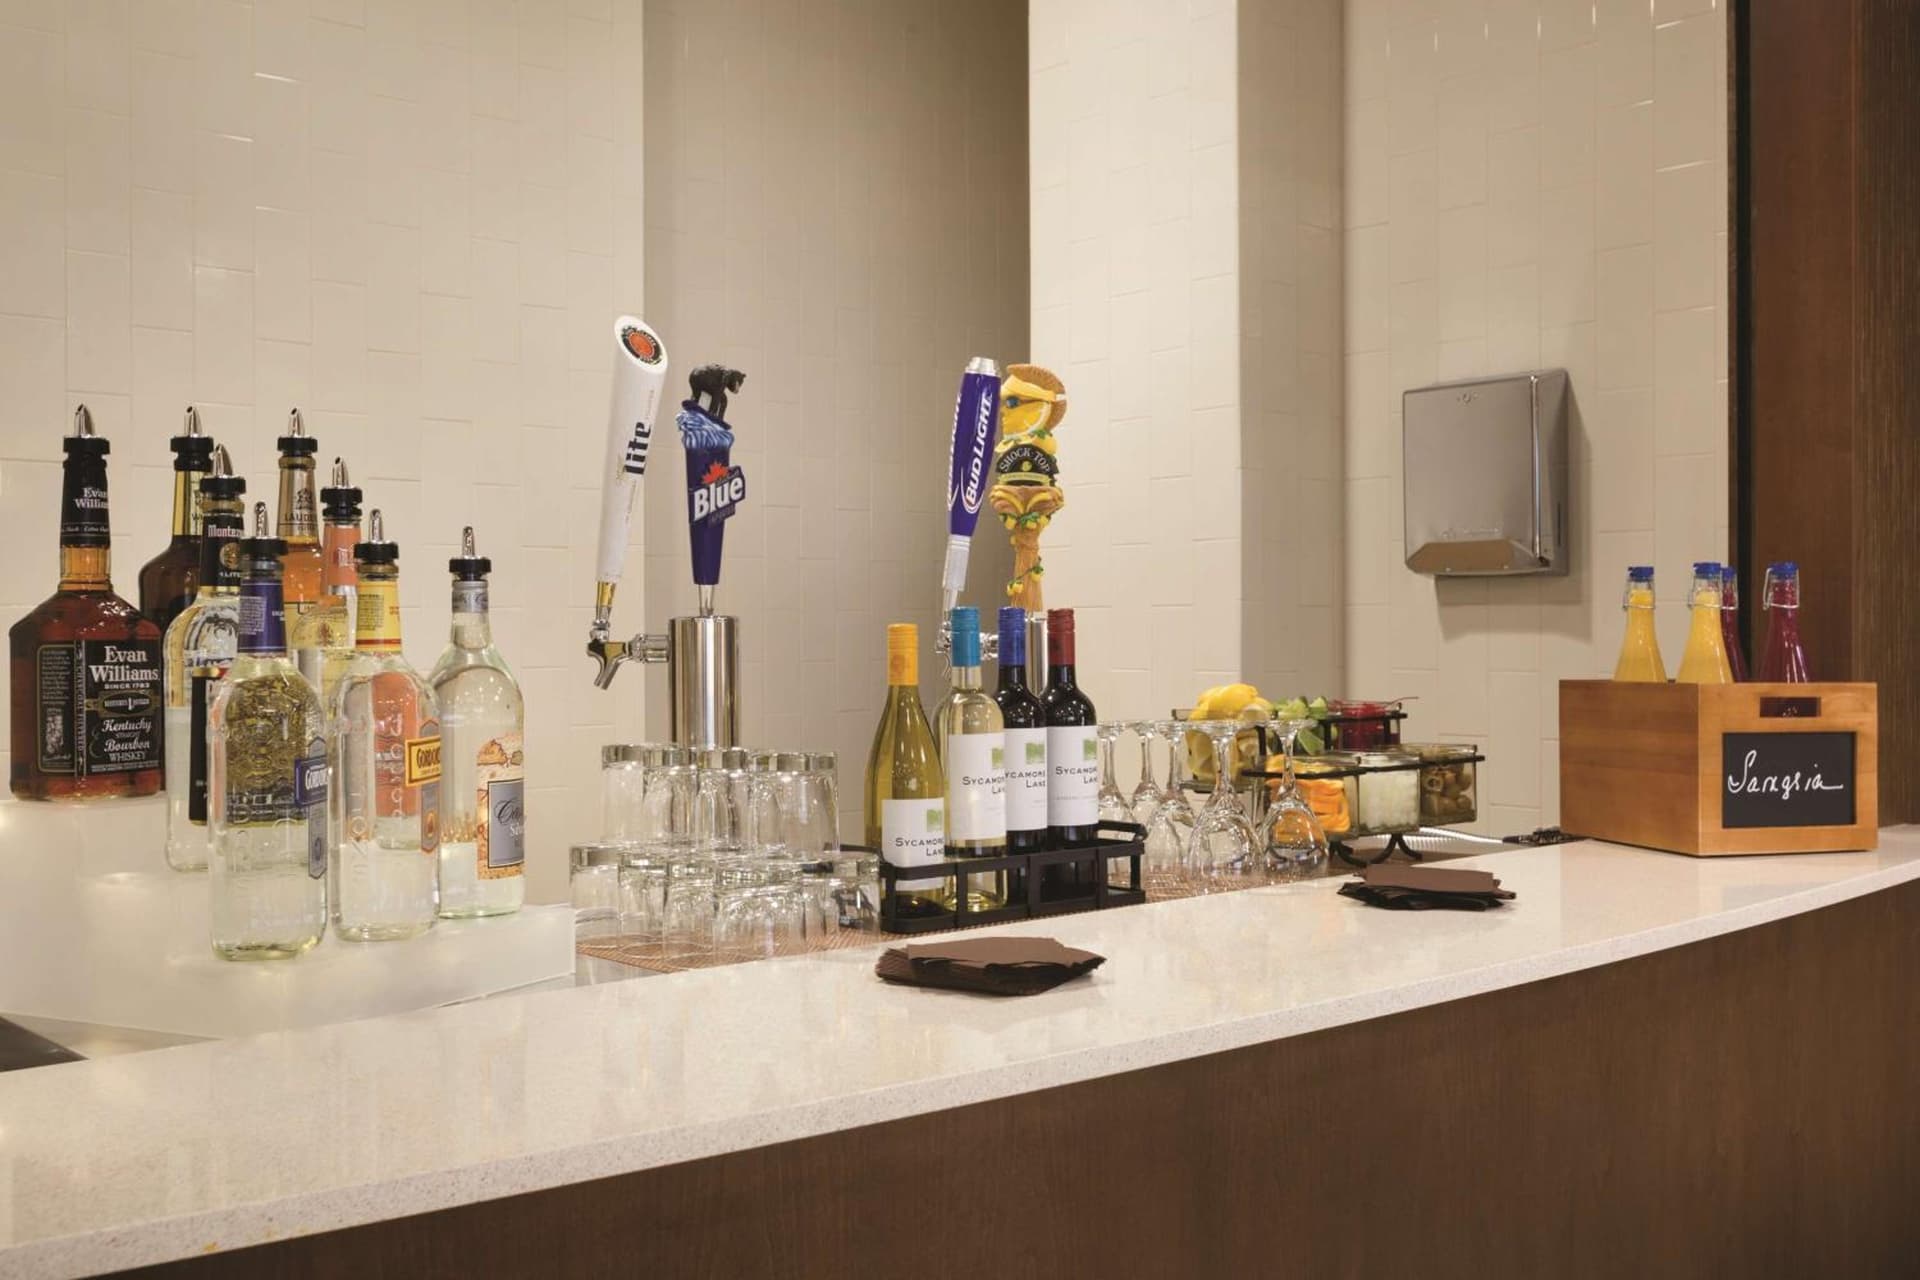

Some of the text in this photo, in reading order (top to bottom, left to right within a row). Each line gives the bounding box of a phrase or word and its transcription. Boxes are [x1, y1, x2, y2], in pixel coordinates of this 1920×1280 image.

[964, 387, 993, 505] BUD LIGHT
[1000, 447, 1050, 472] SHOCK TOP
[694, 477, 743, 521] Blue
[104, 645, 148, 663] Evan
[88, 665, 159, 683] Williams
[101, 718, 152, 733] Kentucky
[104, 737, 150, 753] Bourbon
[109, 751, 146, 762] WHISKEY
[1727, 749, 1844, 800] Sangria
